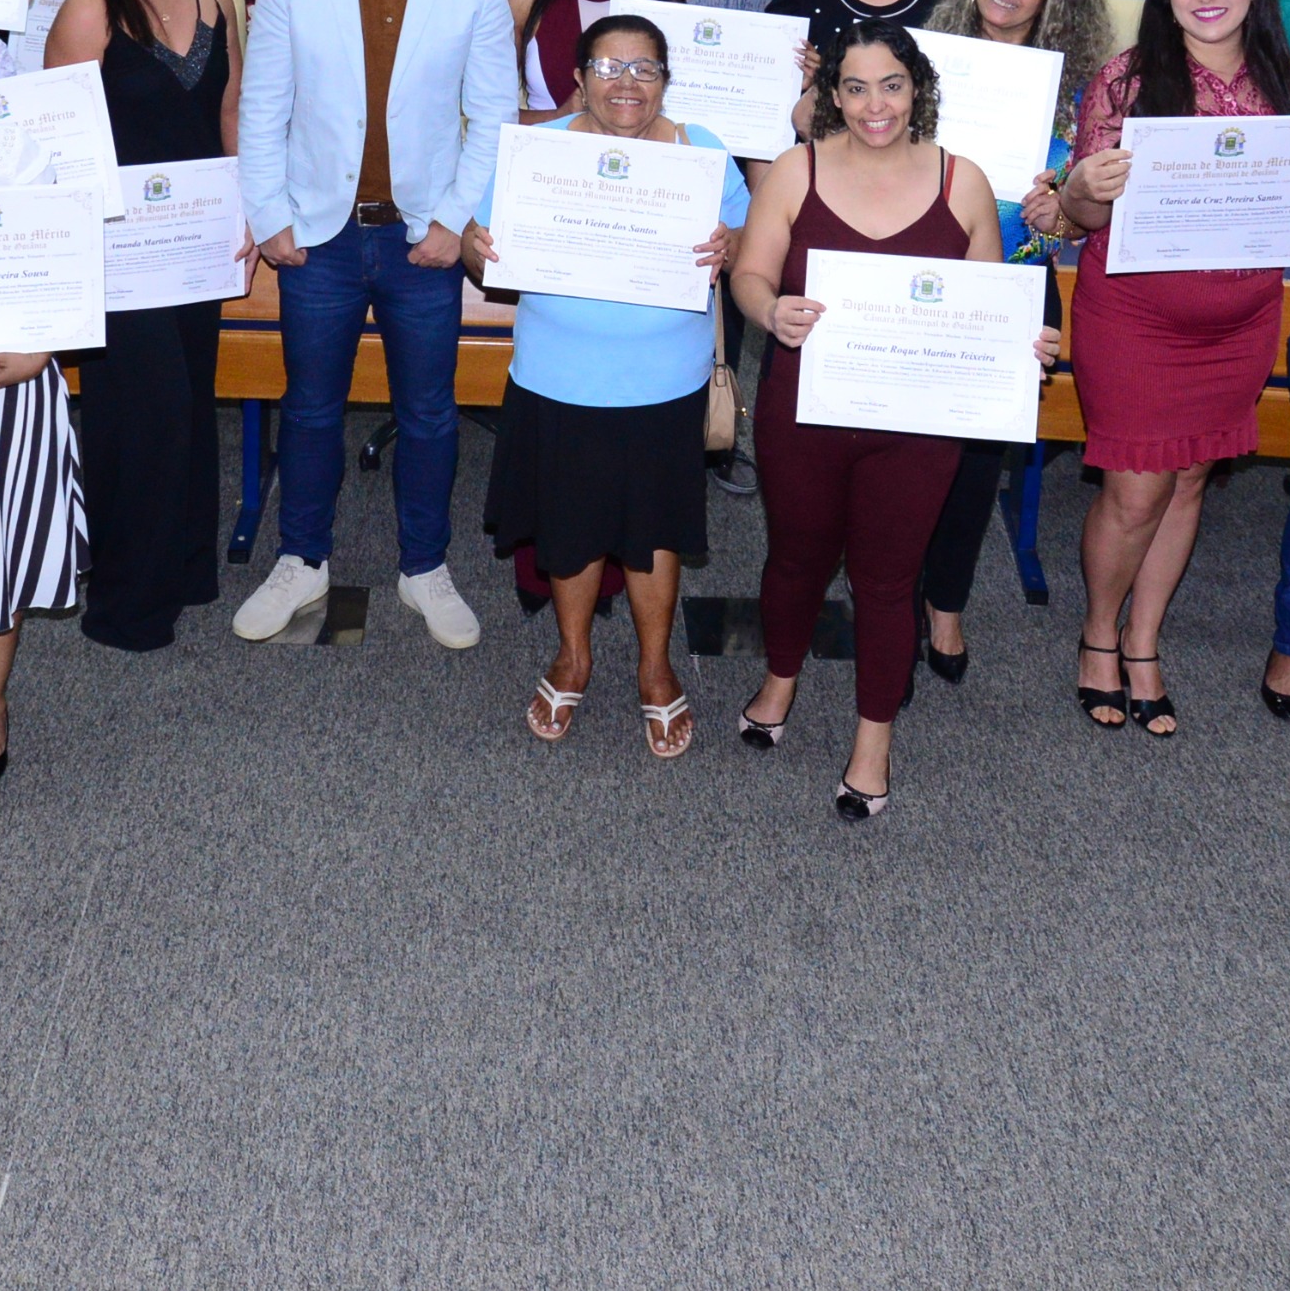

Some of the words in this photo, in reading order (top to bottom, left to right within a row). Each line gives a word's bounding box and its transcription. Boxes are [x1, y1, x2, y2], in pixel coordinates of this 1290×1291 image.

[1159, 198, 1190, 206] Clarice
[1203, 197, 1223, 205] Cruz
[1225, 196, 1255, 204] Pereira
[1256, 194, 1283, 203] Santos
[552, 214, 583, 226] Cleusa
[584, 217, 611, 229] Vieira
[628, 224, 659, 236] Santos
[21, 270, 49, 278] Sousa
[846, 341, 888, 353] Cristiane
[889, 344, 920, 357] Roque
[923, 348, 957, 358] Martins
[960, 351, 996, 362] Teixeira
